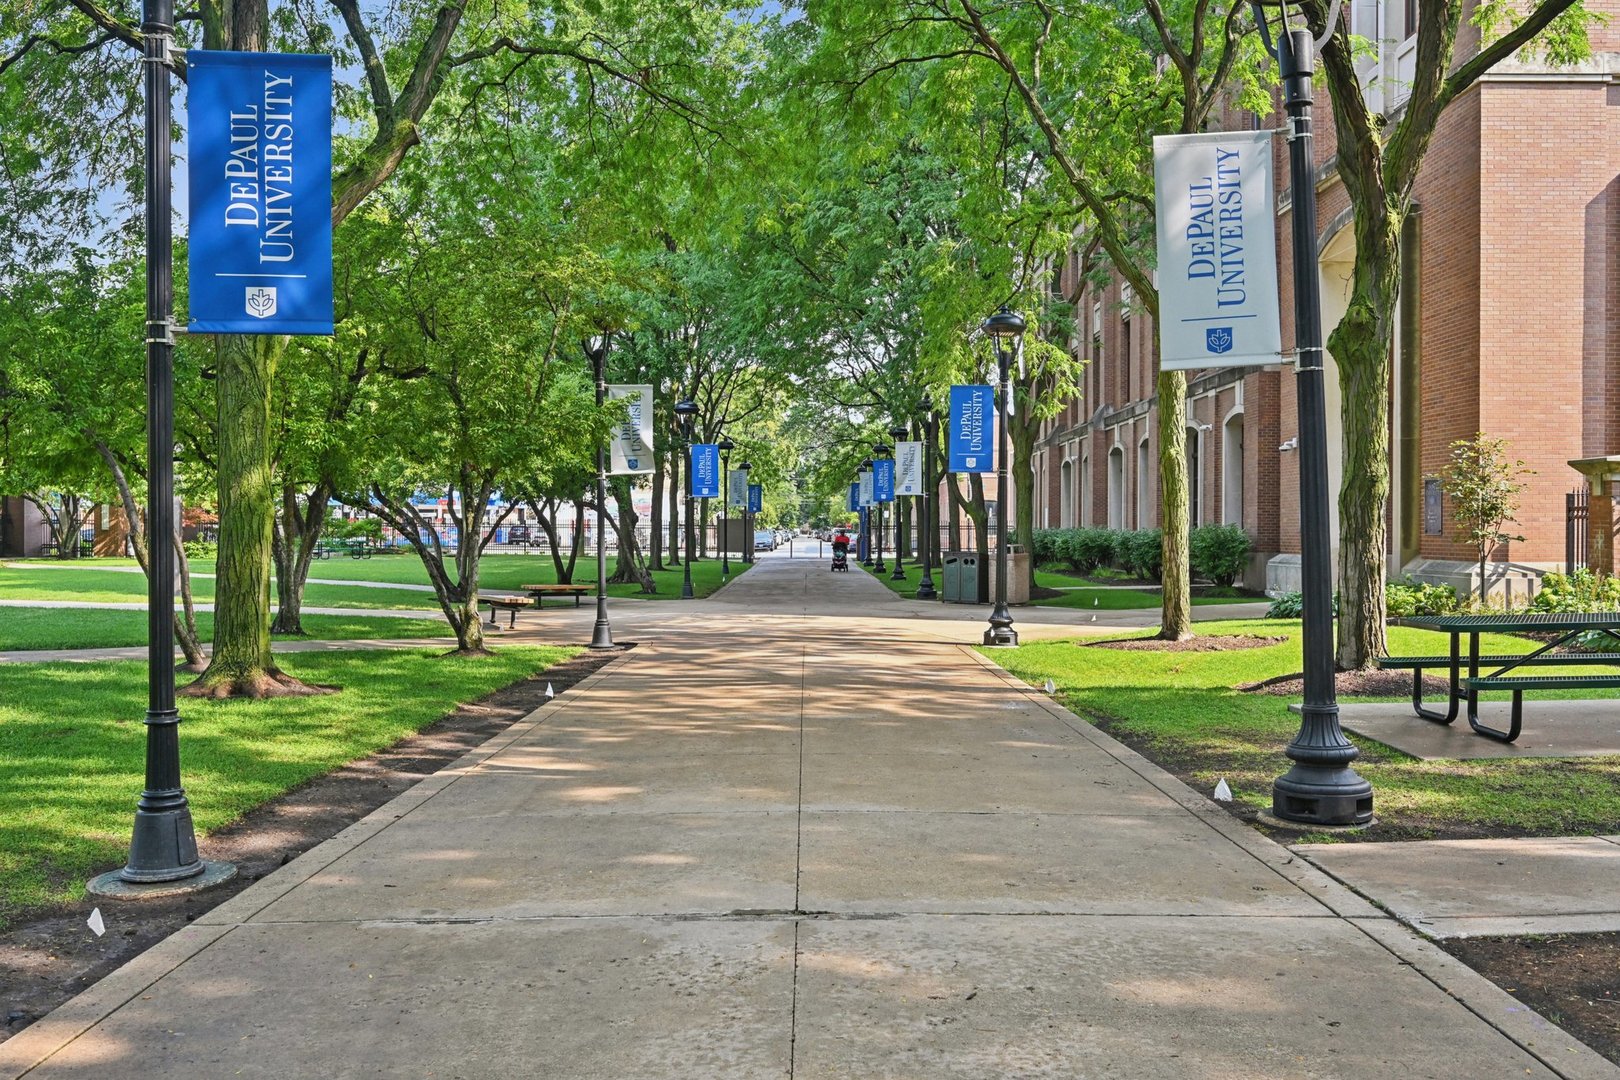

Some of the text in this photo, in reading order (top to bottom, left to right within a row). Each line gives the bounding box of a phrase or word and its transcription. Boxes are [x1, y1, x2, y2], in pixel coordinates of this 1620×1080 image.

[224, 104, 259, 229] DEPAUL
[259, 70, 295, 265] UNIVERSITY
[1186, 177, 1216, 281] DEPAUL
[1216, 147, 1247, 309] UNIVERSITY
[971, 390, 983, 451] UNIVERSITY
